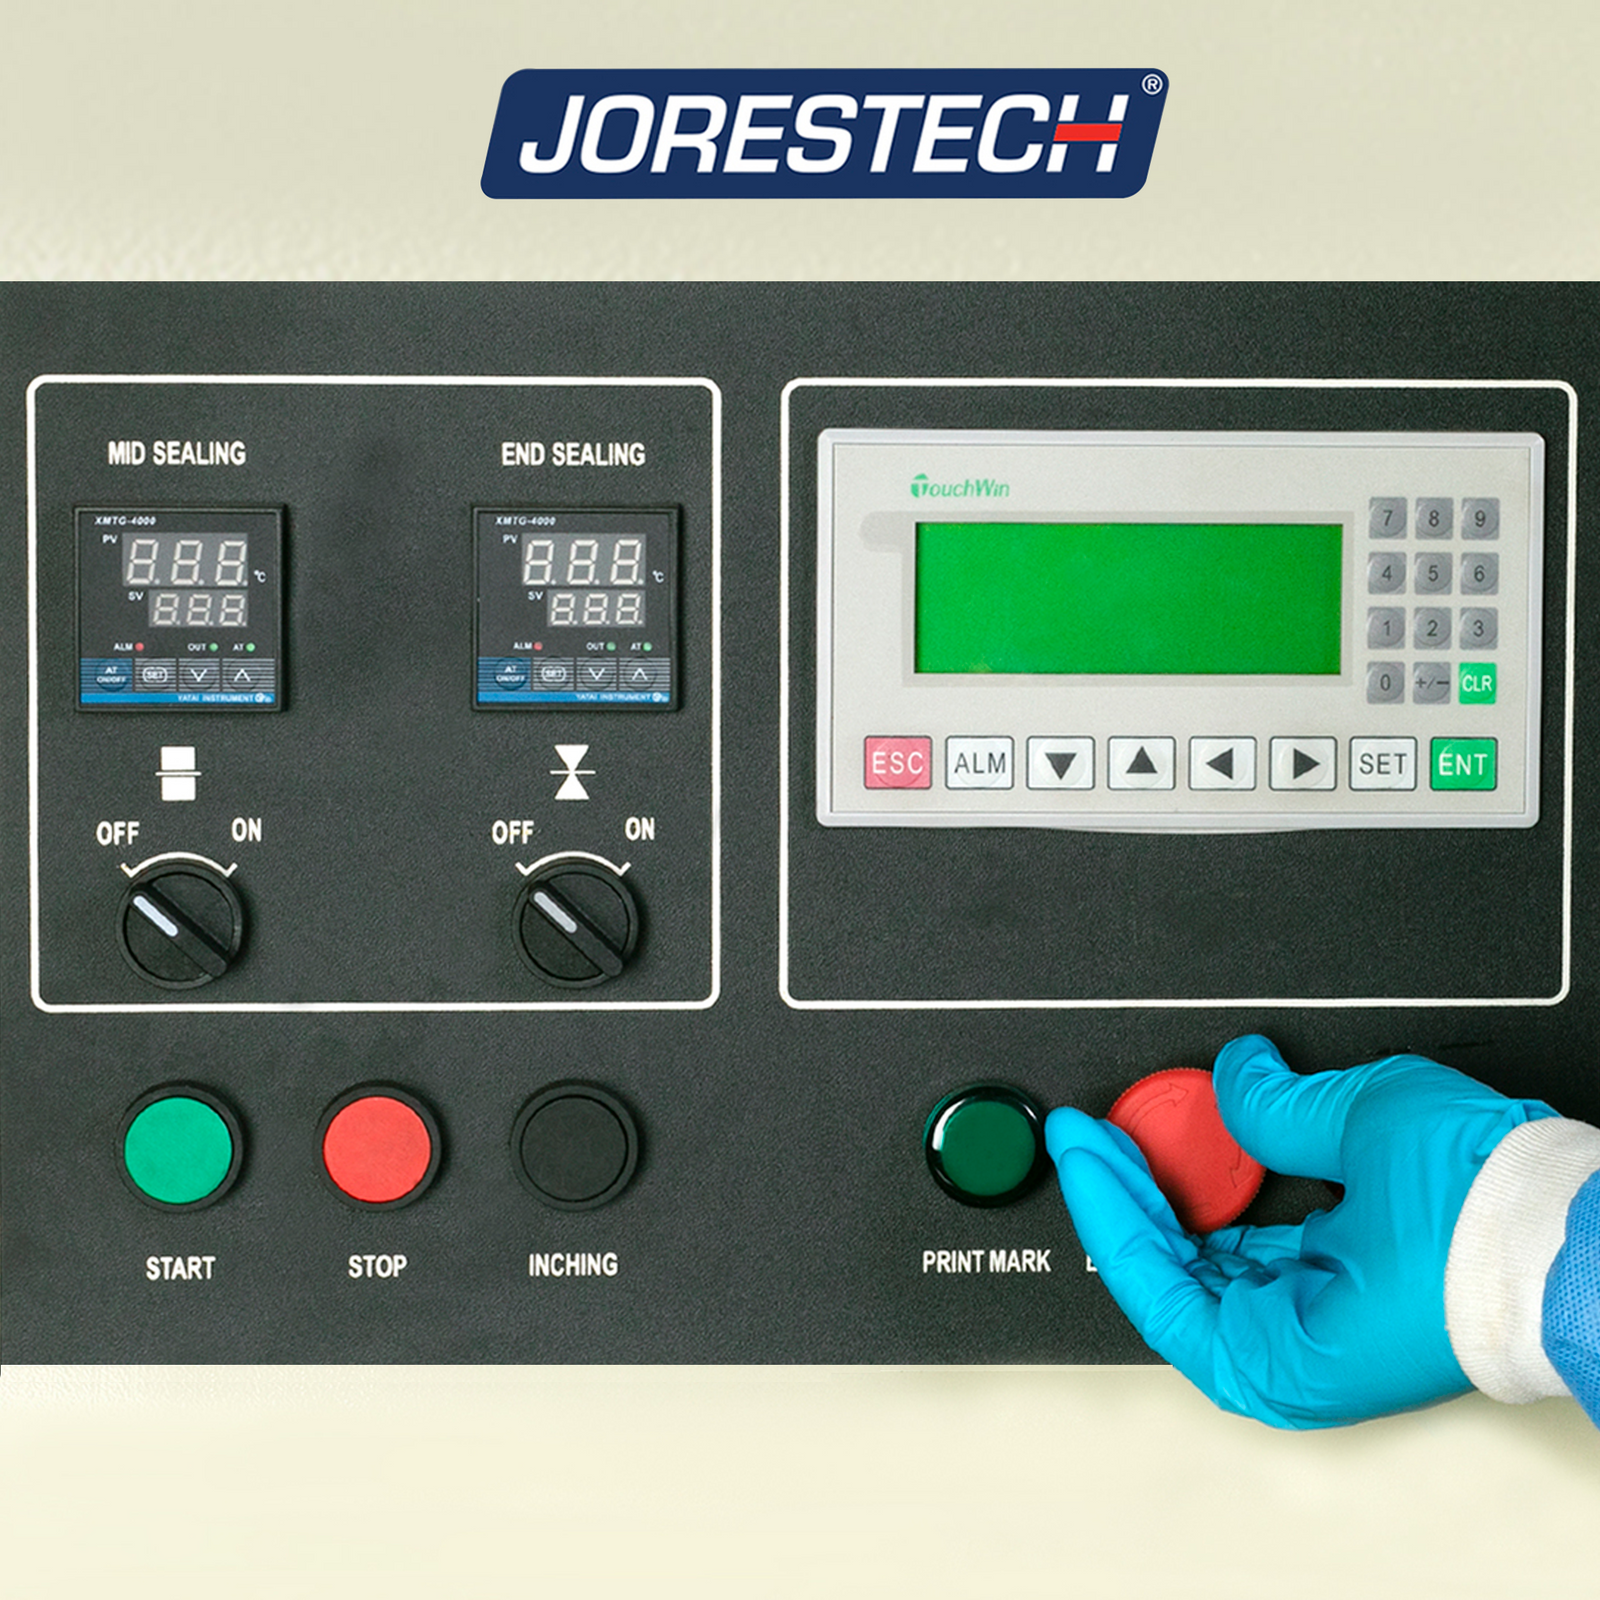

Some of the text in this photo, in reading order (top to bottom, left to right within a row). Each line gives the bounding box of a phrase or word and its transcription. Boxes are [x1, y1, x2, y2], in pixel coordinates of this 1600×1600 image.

[108, 441, 247, 466] MID SEALING
[501, 442, 646, 466] END SEALING
[911, 473, 1010, 498] TouchWin
[495, 515, 557, 526] XMTG-4000
[1383, 510, 1486, 527] 7 8 9
[102, 534, 118, 544] PV
[503, 534, 518, 544] PV
[1382, 565, 1485, 582] 4 5 6
[128, 591, 143, 601] SV
[528, 591, 543, 600] SV
[1383, 620, 1484, 637] 1 2 3
[113, 642, 133, 651] ALM
[188, 642, 206, 651] OUT
[232, 642, 244, 651] AT
[513, 641, 532, 650] ALM
[586, 641, 605, 650] OUT
[630, 641, 642, 650] AT
[105, 666, 118, 675] AT
[504, 665, 517, 673] AT
[1380, 674, 1391, 691] 0
[1462, 675, 1492, 692] CLR
[202, 693, 253, 702] INSTRUMENT
[600, 692, 651, 701] INSTRUMENT
[872, 751, 924, 775] ESC
[954, 751, 1006, 775] ALM
[1359, 752, 1407, 775] SET
[1439, 752, 1487, 776] ENT
[96, 821, 139, 846] OFF
[231, 817, 262, 842] ON
[492, 820, 534, 845] OFF
[625, 816, 655, 841] ON
[146, 1256, 215, 1280] START
[348, 1254, 407, 1278] STOP
[529, 1252, 619, 1276] INCHING
[923, 1250, 1051, 1273] PRINT MARK
